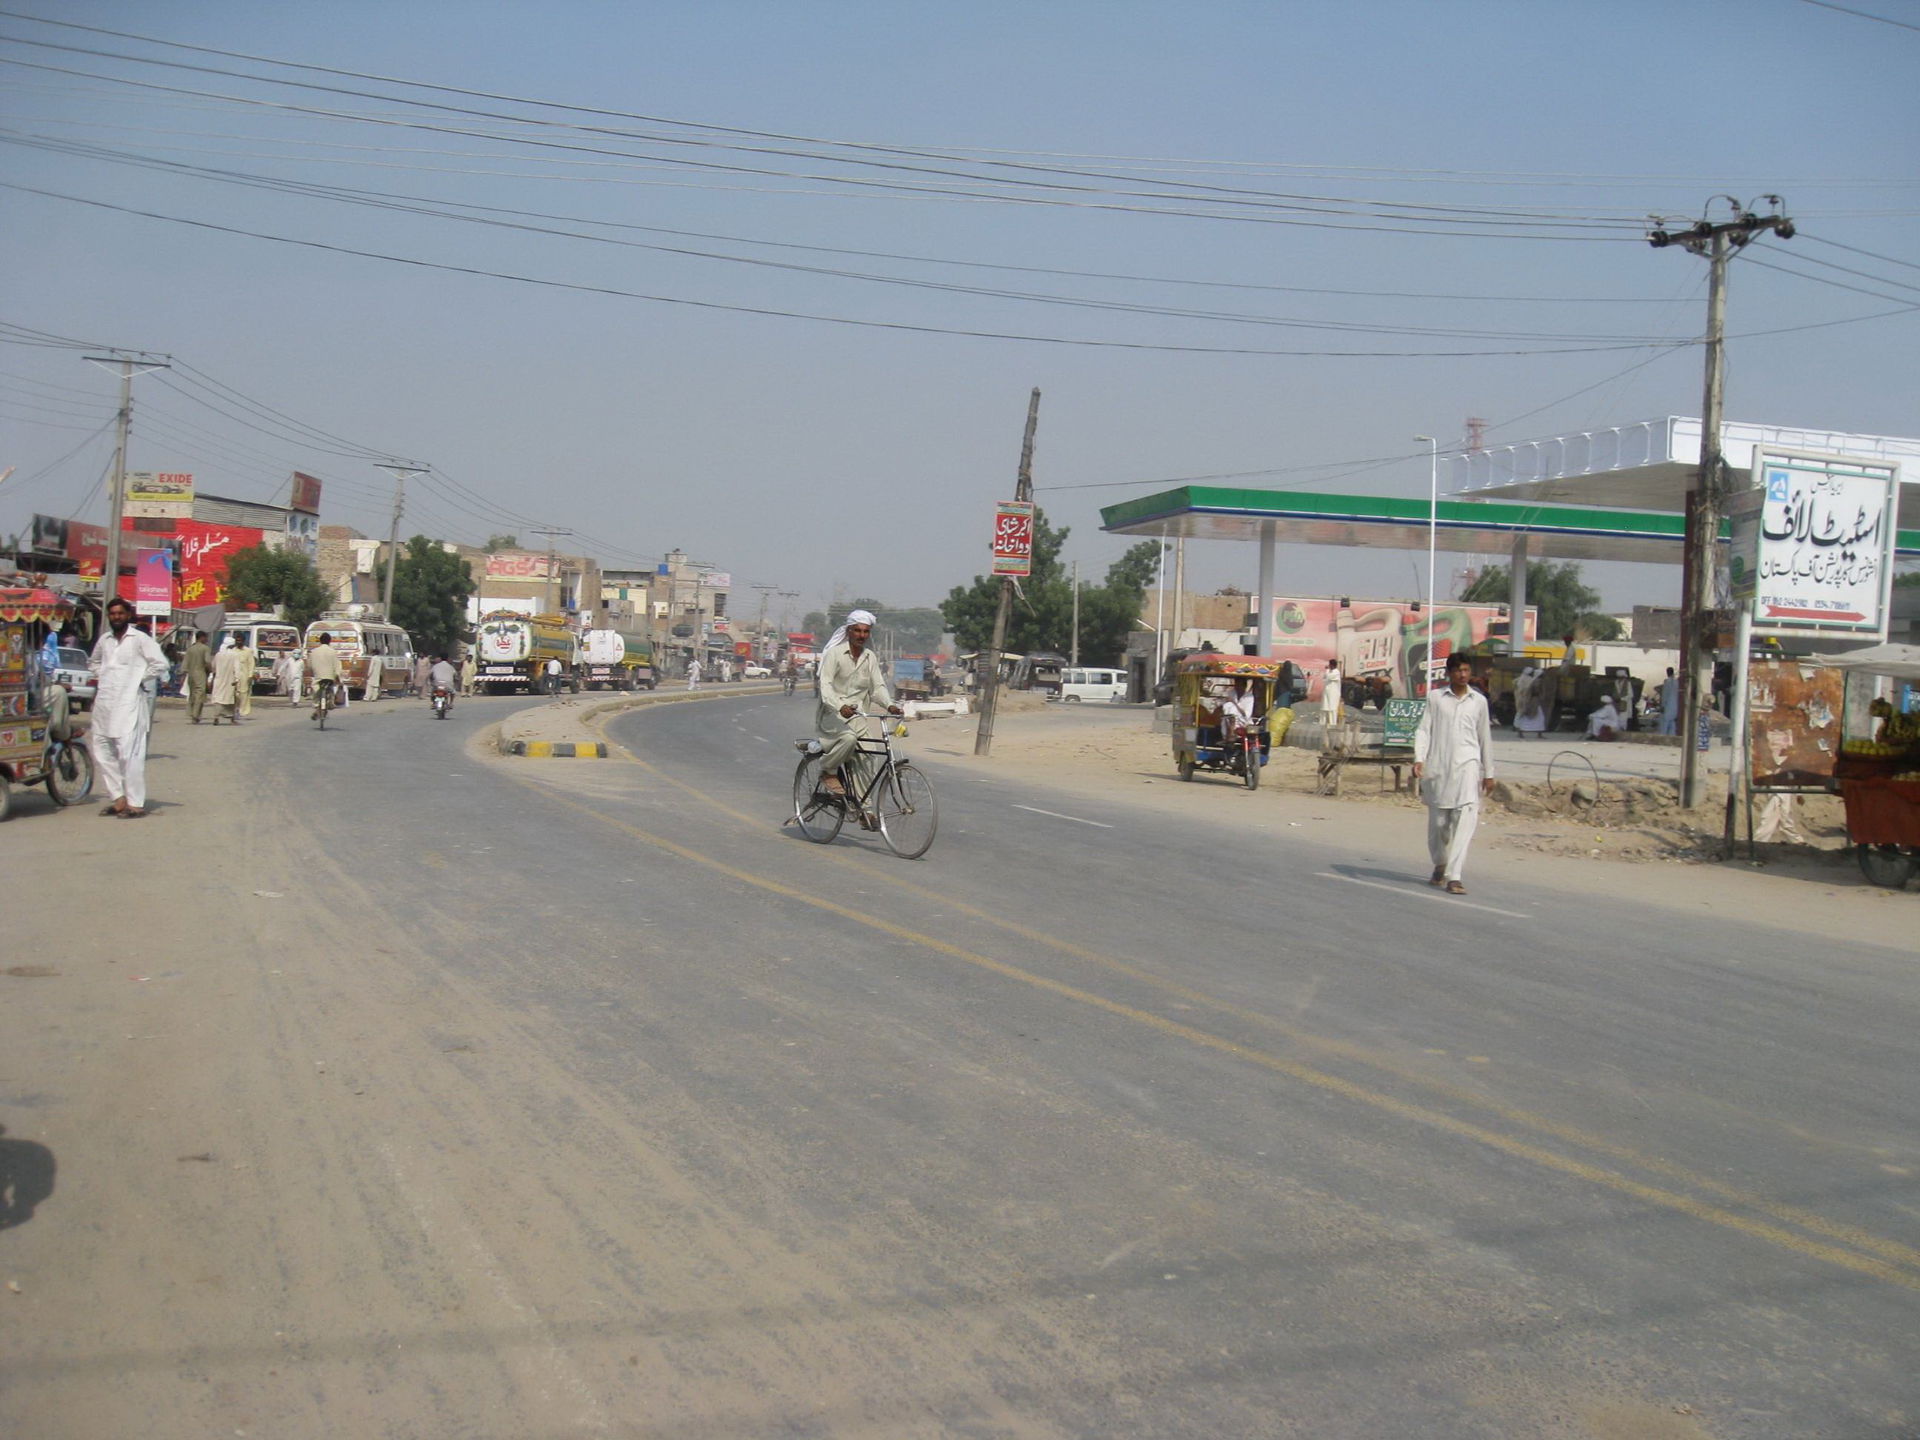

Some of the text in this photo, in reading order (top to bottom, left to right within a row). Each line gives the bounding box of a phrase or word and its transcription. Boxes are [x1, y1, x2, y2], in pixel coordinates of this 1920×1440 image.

[158, 472, 192, 484] EXIDE
[1762, 489, 1882, 563] اسٹیٹ لائف
[1760, 549, 1802, 586] پاکستان
